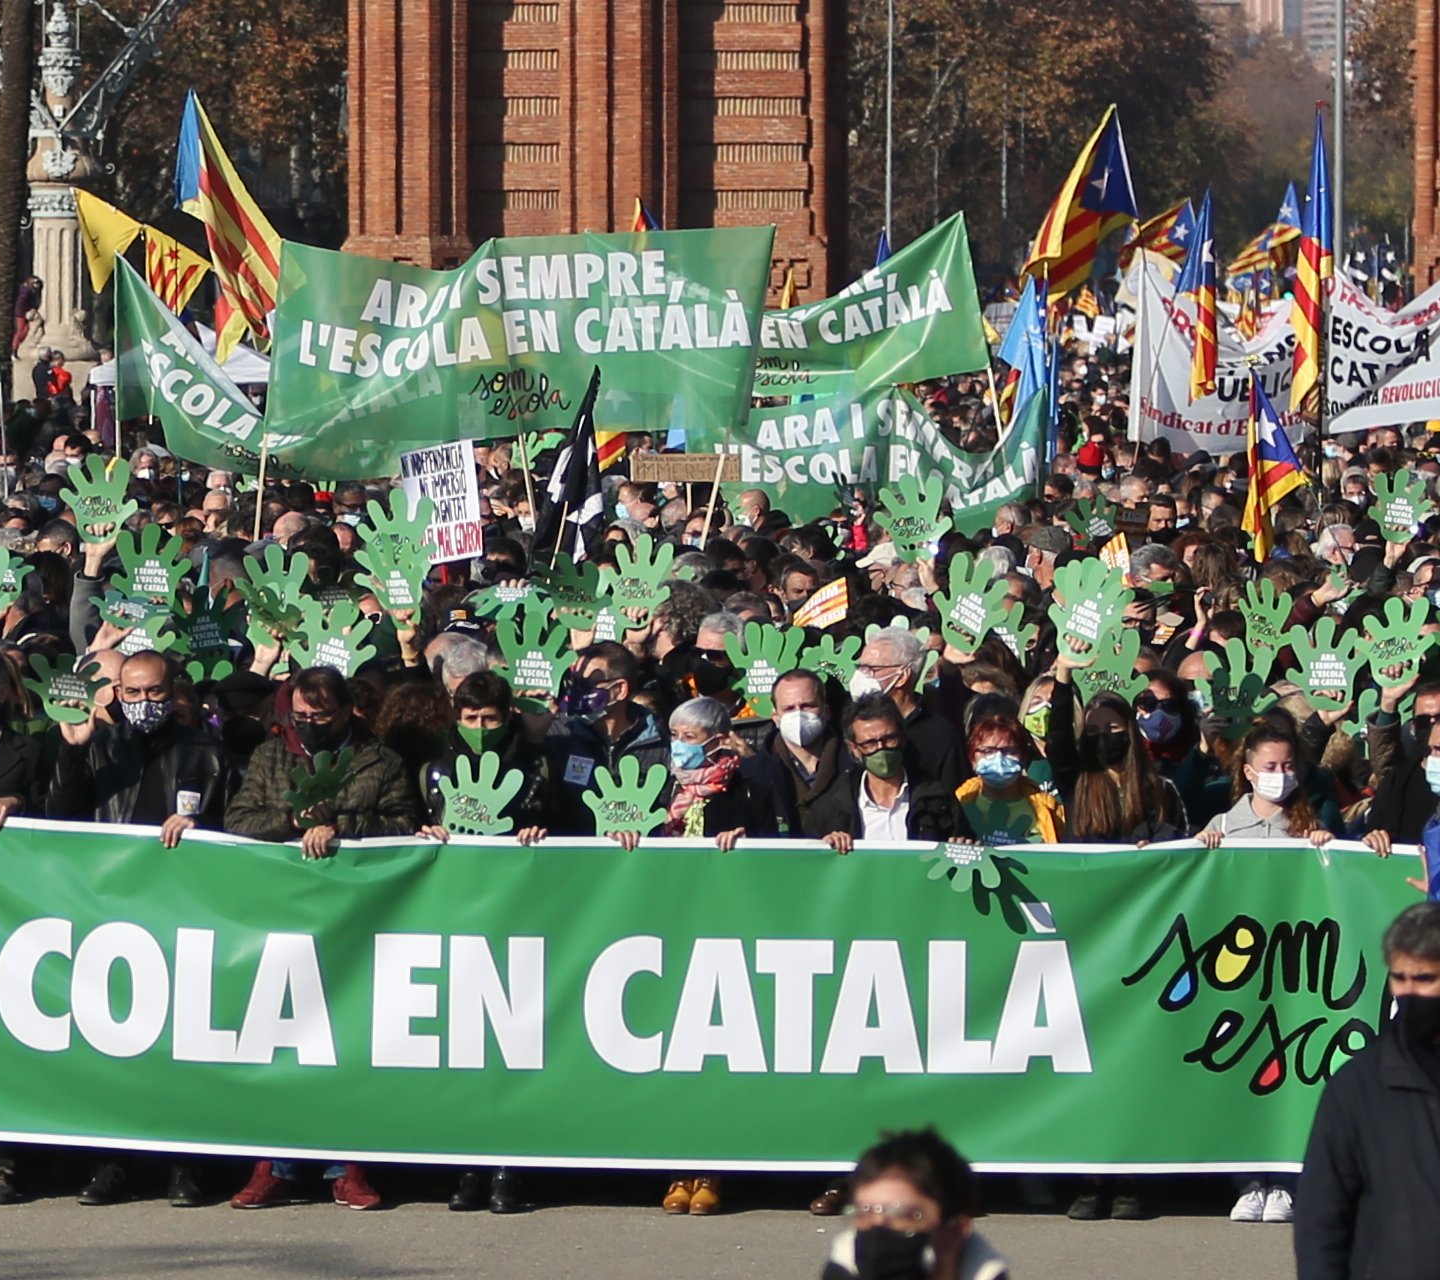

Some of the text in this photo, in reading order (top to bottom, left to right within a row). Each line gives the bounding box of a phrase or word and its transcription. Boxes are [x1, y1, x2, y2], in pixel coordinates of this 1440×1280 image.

[476, 250, 684, 304] SEMPRE,
[761, 314, 808, 349] EN
[819, 269, 952, 344] CATALÀ
[299, 290, 752, 378] L'ESCOLA EN CATALÀ
[469, 369, 537, 401] som
[488, 373, 571, 420] escola
[757, 404, 863, 451] ARA I
[939, 441, 1039, 509] ATALÀ
[1388, 510, 1411, 518] L'ESCOLA
[133, 583, 143, 591] EN
[136, 575, 166, 583] L'ESCOLA
[515, 677, 524, 685] EN
[517, 669, 550, 677] L'ESCOLA
[1312, 670, 1344, 678] L'ESCOLA
[1121, 913, 1367, 1012] som
[369, 934, 547, 1071] EN
[584, 901, 1093, 1077] CATALÀ
